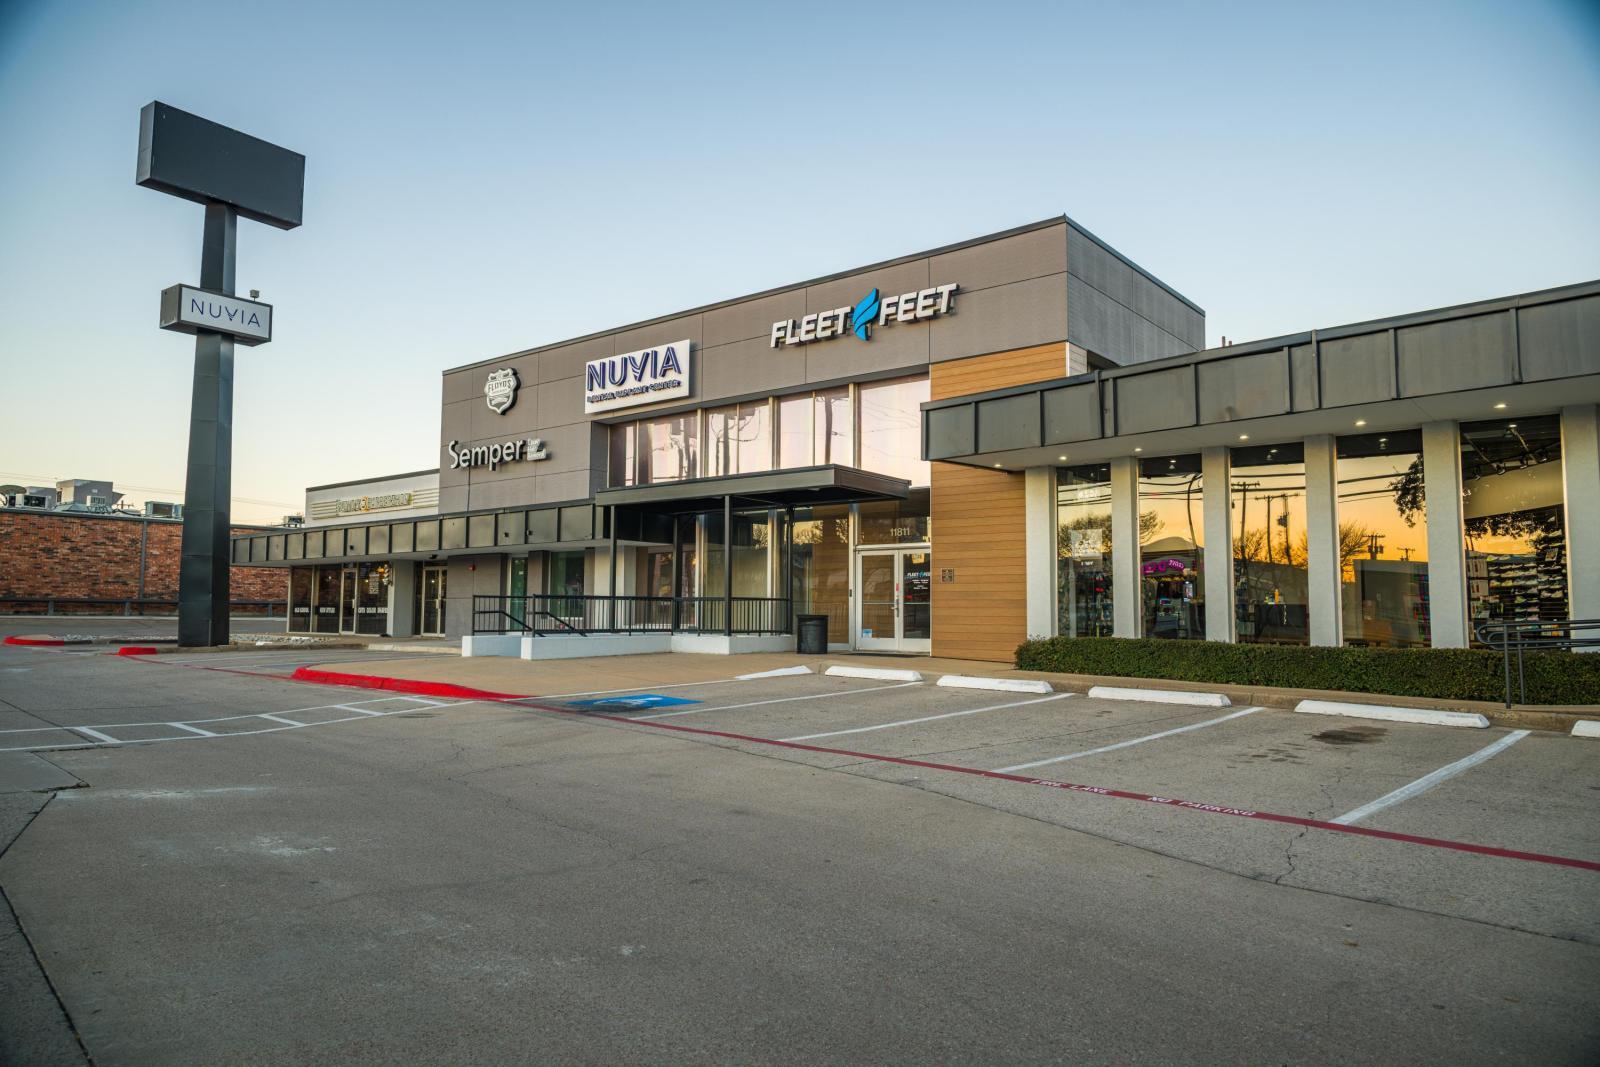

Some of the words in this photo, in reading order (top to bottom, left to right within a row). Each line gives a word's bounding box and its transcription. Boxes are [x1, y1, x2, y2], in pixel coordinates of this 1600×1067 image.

[191, 298, 260, 327] NUVIA
[770, 306, 851, 348] FLEET
[879, 283, 957, 326] FEET
[587, 346, 681, 391] NUVIA
[448, 440, 524, 471] Semper
[890, 527, 910, 537] 11811
[1070, 785, 1107, 794] LANE
[1179, 801, 1257, 816] PARKING
